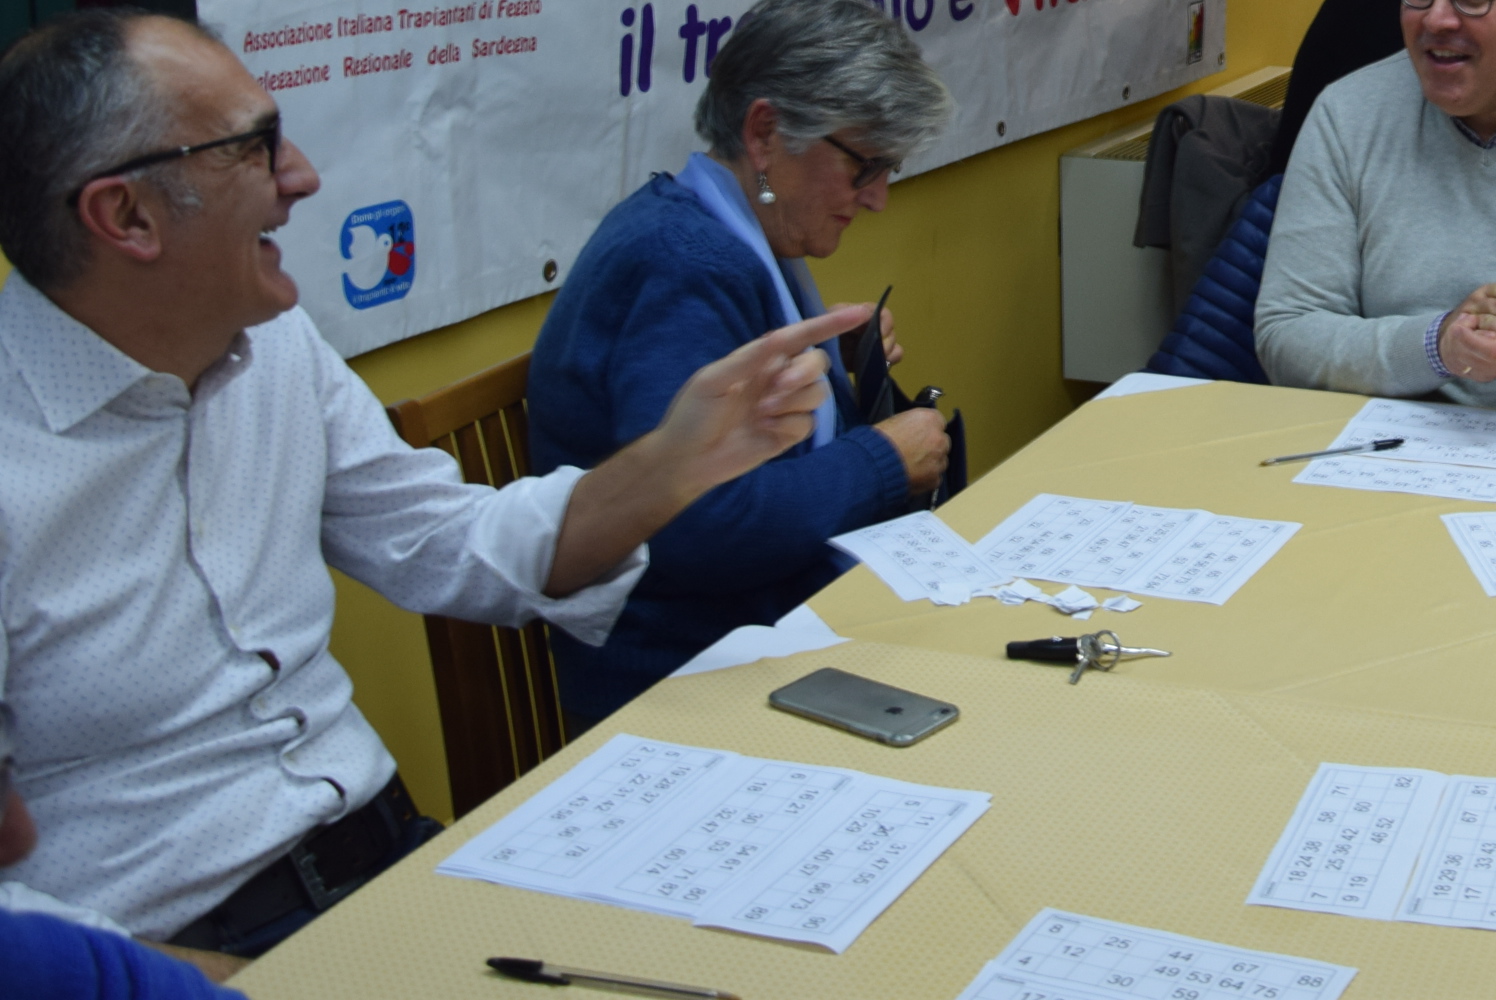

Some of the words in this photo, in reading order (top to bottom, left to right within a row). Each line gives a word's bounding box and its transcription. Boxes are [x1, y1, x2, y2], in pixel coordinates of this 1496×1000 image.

[243, 20, 332, 54] Associazione
[337, 13, 392, 37] Italiana
[397, 1, 476, 30] Trapiantati
[478, 0, 493, 20] di
[620, 2, 655, 97] il
[343, 49, 413, 78] Regionale
[427, 45, 461, 66] della
[472, 36, 538, 59] Sardegna
[620, 758, 641, 768] 13
[670, 766, 691, 776] 19
[628, 772, 651, 785] 22
[653, 777, 676, 790] 28
[1394, 776, 1413, 788] 82
[613, 786, 634, 798] 31
[746, 782, 767, 792] 18
[1330, 785, 1349, 795] 71
[1471, 784, 1488, 796] 81
[568, 795, 589, 807] 43
[639, 791, 660, 804] 37
[798, 790, 819, 801] 16
[594, 799, 615, 812] 42
[784, 801, 806, 814] 21
[714, 807, 737, 820] 32
[740, 812, 763, 824] 30
[860, 808, 881, 819] 10
[1460, 810, 1478, 823] 67
[700, 820, 719, 833] 47
[845, 820, 868, 833] 29
[915, 816, 935, 826] 11
[1375, 817, 1395, 829] 52
[1370, 831, 1388, 844] 46
[564, 845, 590, 857] 78
[707, 839, 731, 852] 53
[735, 845, 758, 856] 54
[856, 839, 879, 851] 33
[885, 843, 907, 855] 31
[1302, 840, 1322, 853] 38
[1310, 891, 1328, 899] 7
[1324, 858, 1345, 871] 25
[1340, 828, 1359, 841] 42
[1353, 801, 1372, 813] 60
[663, 848, 687, 860] 60
[813, 848, 834, 861] 40
[646, 862, 669, 874] 74
[719, 858, 741, 870] 61
[871, 857, 889, 870] 47
[1294, 855, 1313, 868] 24
[673, 868, 698, 880] 71
[799, 863, 820, 876] 57
[1287, 870, 1307, 881] 18
[1437, 868, 1457, 882] 29
[852, 872, 876, 884] 55
[1348, 875, 1368, 887] 19
[1463, 886, 1482, 899] 17
[1473, 857, 1493, 869] 33
[657, 882, 679, 896] 87
[682, 887, 706, 901] 80
[1432, 884, 1452, 896] 18
[790, 897, 815, 910] 73
[1341, 894, 1360, 902] 9
[744, 906, 768, 920] 89
[801, 916, 826, 929] 90
[1050, 924, 1064, 934] 8
[1104, 936, 1132, 950] 25
[1168, 951, 1195, 962] 44
[1232, 962, 1260, 974] 67
[1297, 975, 1324, 988] 88
[1018, 956, 1033, 966] 4
[1106, 974, 1134, 987] 30
[1171, 987, 1200, 1000] 59
[1062, 945, 1086, 957] 12
[1154, 966, 1181, 977] 49
[1185, 971, 1213, 984] 53
[1218, 978, 1245, 991] 64
[1252, 984, 1280, 999] 75
